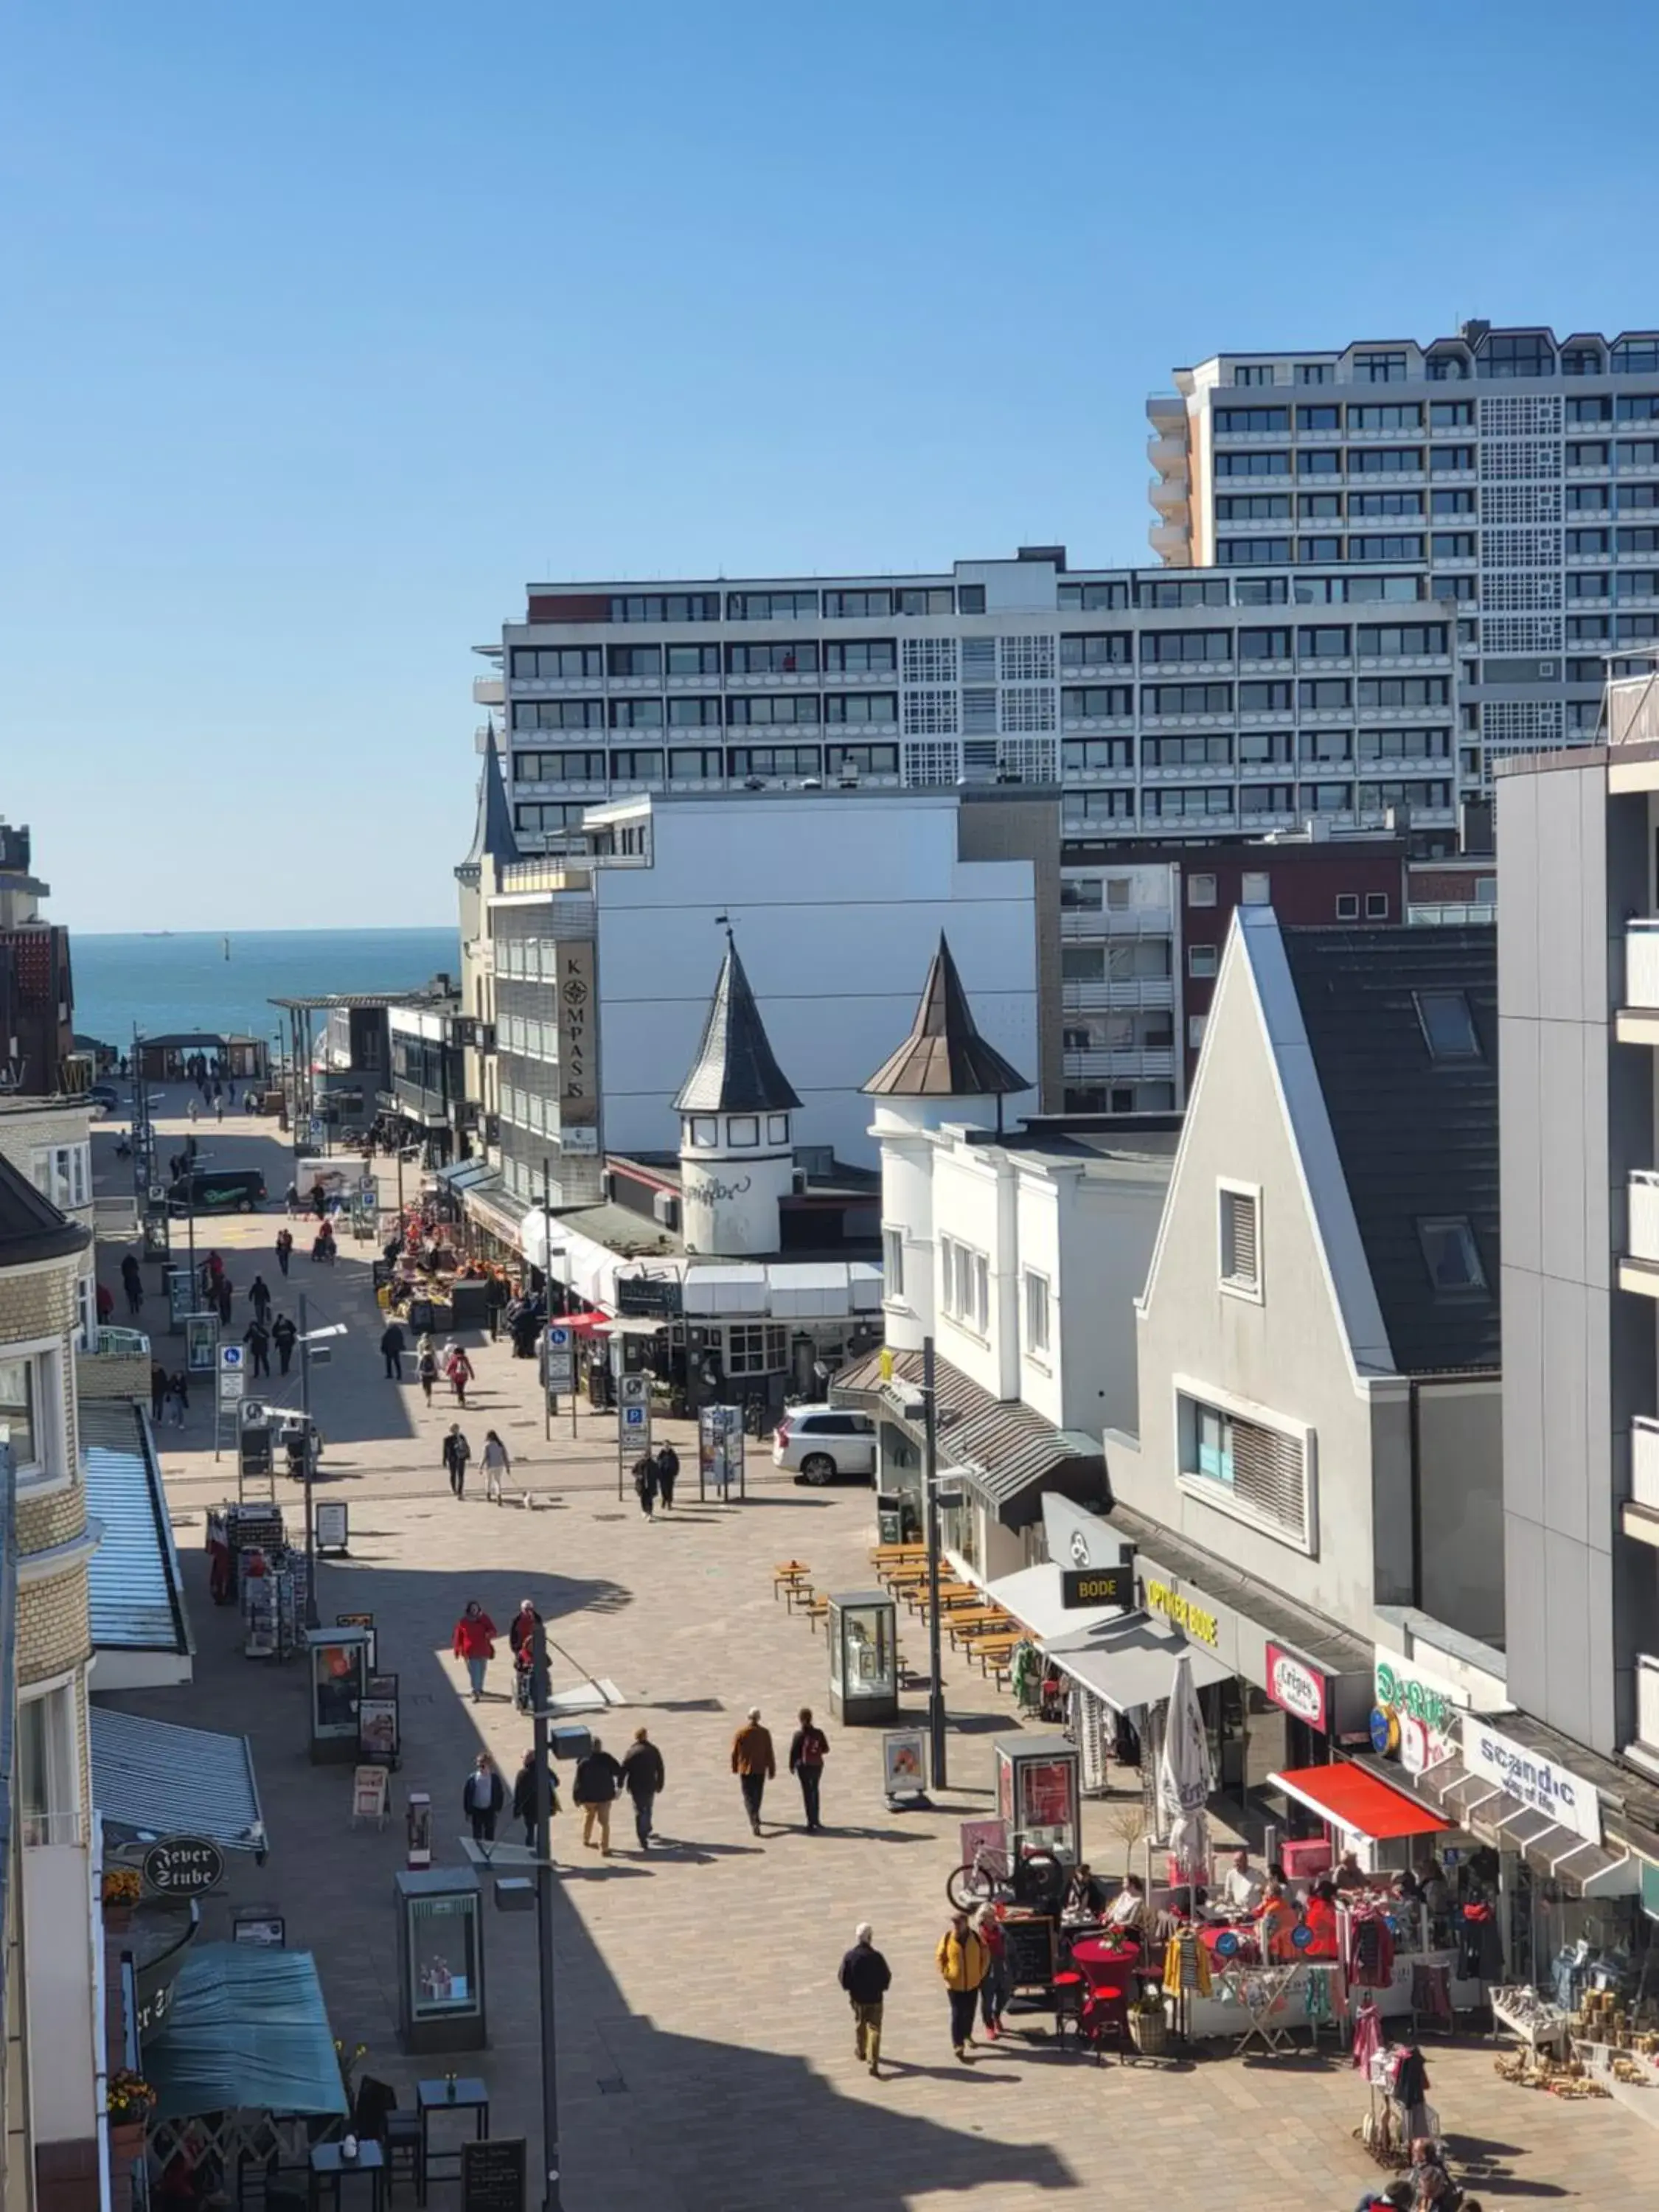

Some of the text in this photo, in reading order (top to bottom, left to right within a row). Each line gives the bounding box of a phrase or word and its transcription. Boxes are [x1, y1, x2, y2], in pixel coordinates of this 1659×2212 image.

[1079, 1579, 1117, 1599] BODE
[156, 1847, 212, 1868] Jever
[156, 1868, 212, 1887] Stube
